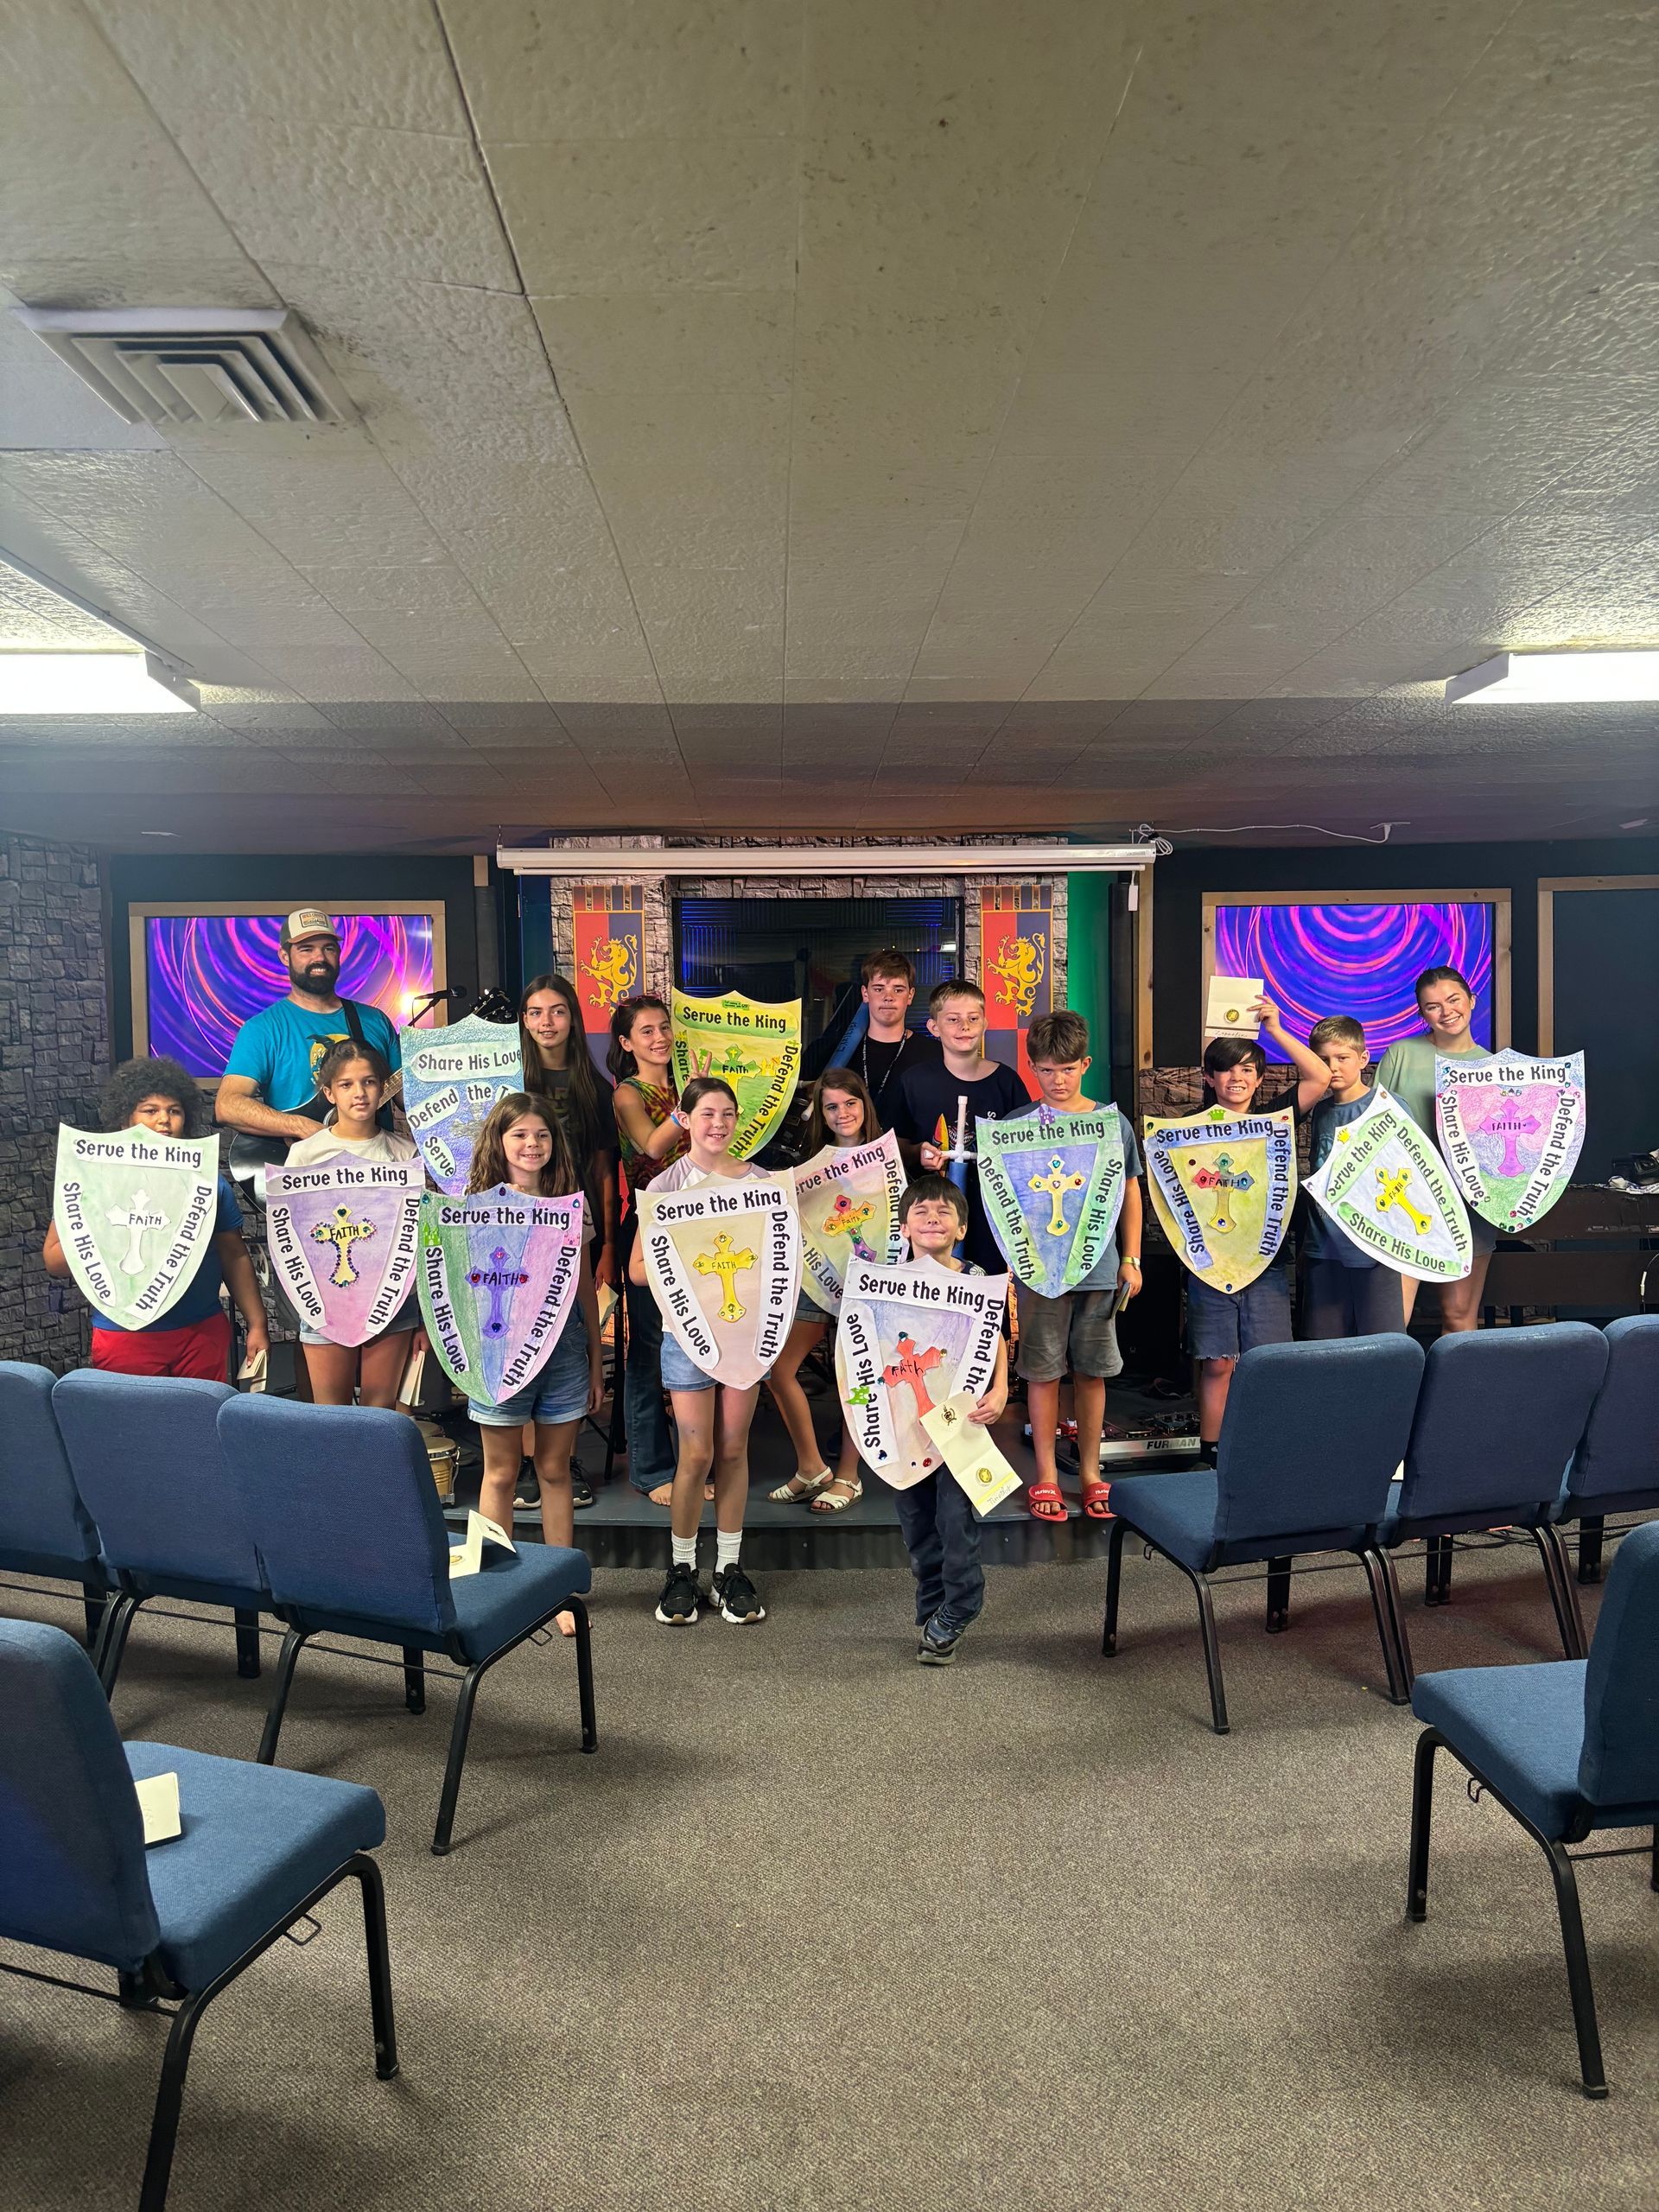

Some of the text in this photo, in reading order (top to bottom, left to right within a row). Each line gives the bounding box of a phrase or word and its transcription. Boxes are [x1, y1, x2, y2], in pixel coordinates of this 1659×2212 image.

[683, 1007, 785, 1033] Serve the King
[418, 1054, 463, 1070] Share
[468, 1054, 490, 1070] His
[675, 1040, 690, 1082] Share
[1449, 1065, 1566, 1084] Serve the King
[408, 1090, 459, 1129] Defend
[467, 1085, 491, 1101] the
[733, 1046, 798, 1153] Defend the Truth
[76, 1139, 201, 1168] Serve the King
[425, 1136, 454, 1177] Serve
[992, 1121, 1104, 1145] Serve the King
[1156, 1120, 1274, 1144] Serve the King
[1355, 1140, 1372, 1162] the
[1368, 1113, 1397, 1142] King
[1442, 1097, 1484, 1198] Share His Love
[1517, 1097, 1575, 1217] Defend the Truth
[283, 1166, 408, 1190] Serve the King
[796, 1146, 886, 1197] erve the King
[1259, 1128, 1291, 1256] Defend the Truth
[1396, 1127, 1467, 1251] Defend the Truth
[442, 1206, 570, 1230] Serve the King
[657, 1202, 704, 1221] Serve
[709, 1195, 738, 1212] the
[978, 1157, 1035, 1281] Defend the Truth
[1080, 1158, 1122, 1271] Share His Love
[1154, 1150, 1205, 1254] Share His Love
[63, 1182, 111, 1299] Share His Love
[136, 1185, 212, 1310] Defend the Truth
[330, 1225, 359, 1241] FAITH
[1350, 1213, 1446, 1272] Share His Love
[272, 1207, 321, 1316] Share His Love
[368, 1198, 419, 1325] Defend the Truth
[483, 1273, 518, 1286] FAITH
[760, 1210, 791, 1358] Defend the Truth
[804, 1248, 843, 1299] His Love
[425, 1247, 466, 1374] Share His Love
[503, 1247, 577, 1387] Defend the Truth
[652, 1236, 710, 1357] Share His Love
[859, 1274, 984, 1313] Serve the King
[846, 1313, 868, 1356] Love
[974, 1299, 1004, 1365] Defend
[856, 1359, 875, 1388] His
